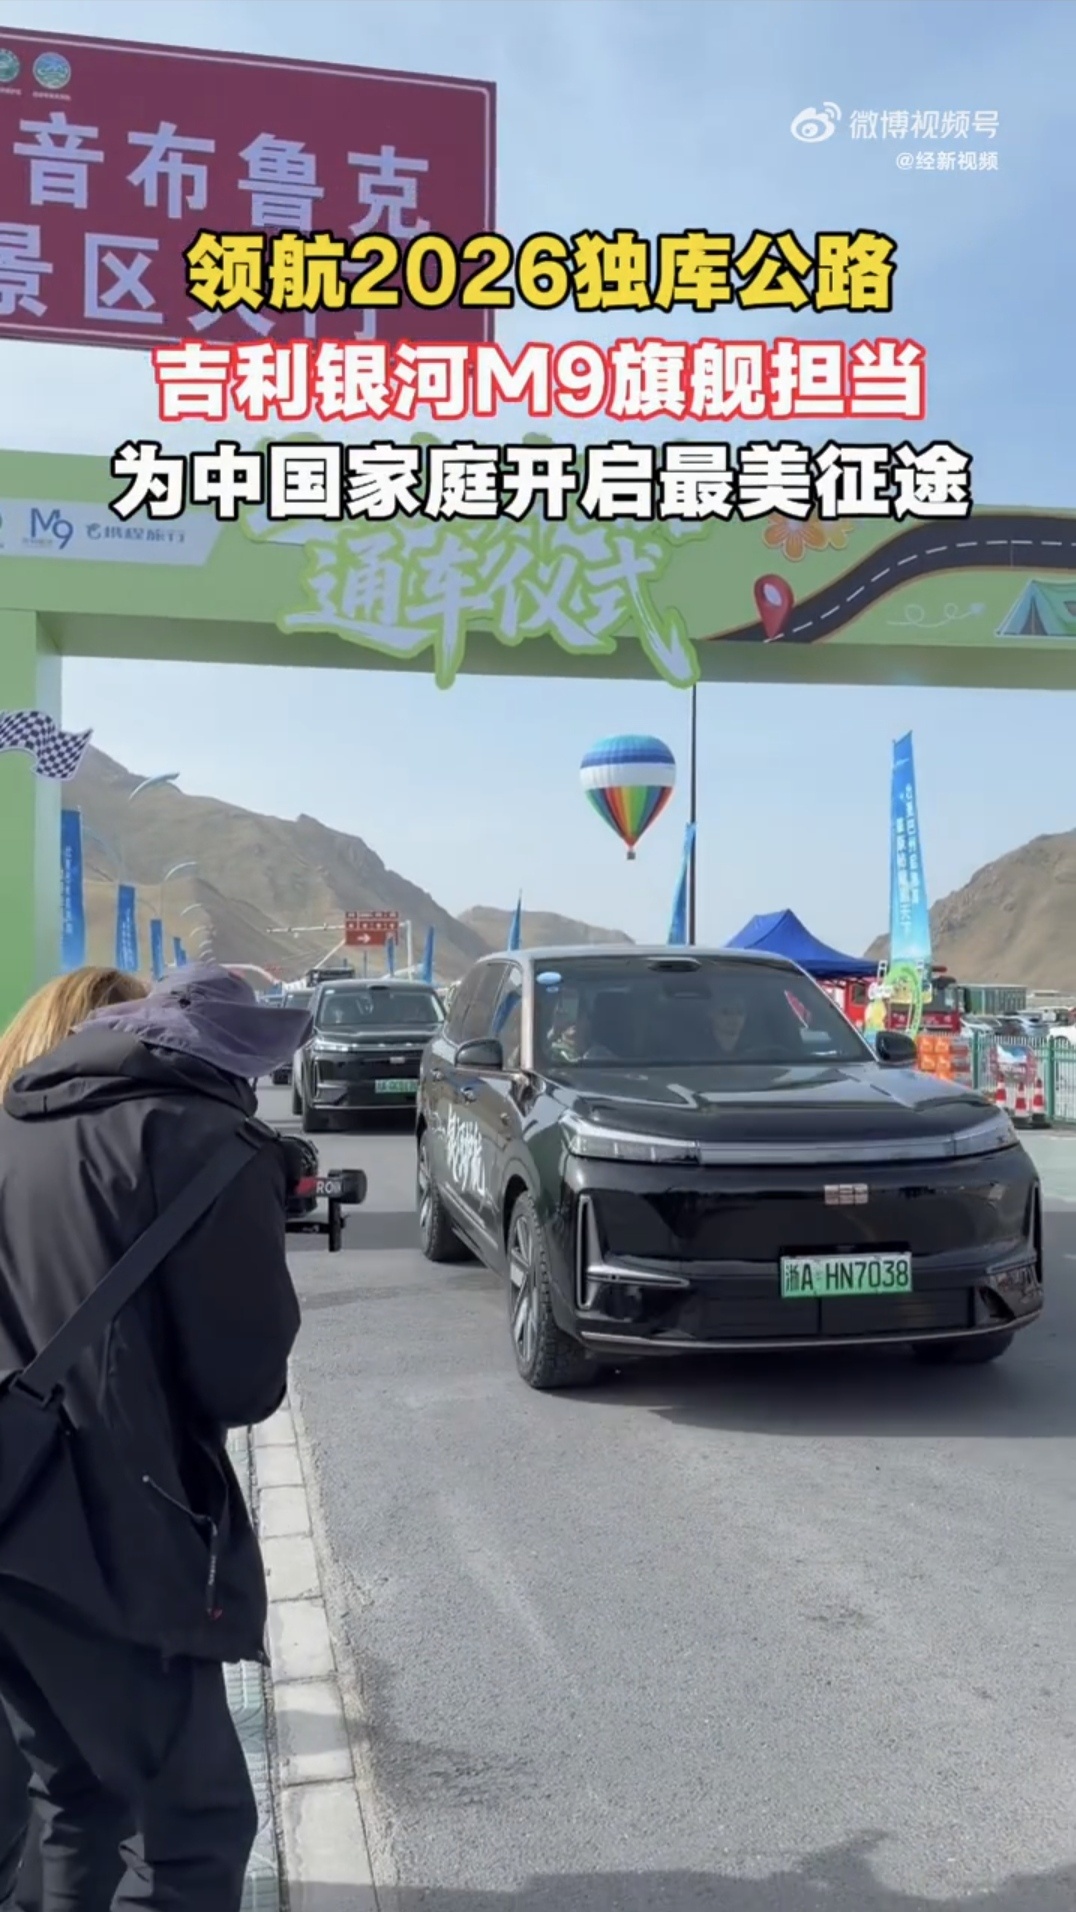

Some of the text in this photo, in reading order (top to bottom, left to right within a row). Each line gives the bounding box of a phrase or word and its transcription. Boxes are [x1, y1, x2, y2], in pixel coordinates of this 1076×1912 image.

[13, 111, 431, 239] 音布鲁克
[30, 507, 74, 549] M9
[282, 530, 697, 685] 通车仪式
[825, 1260, 909, 1290] HN7038
